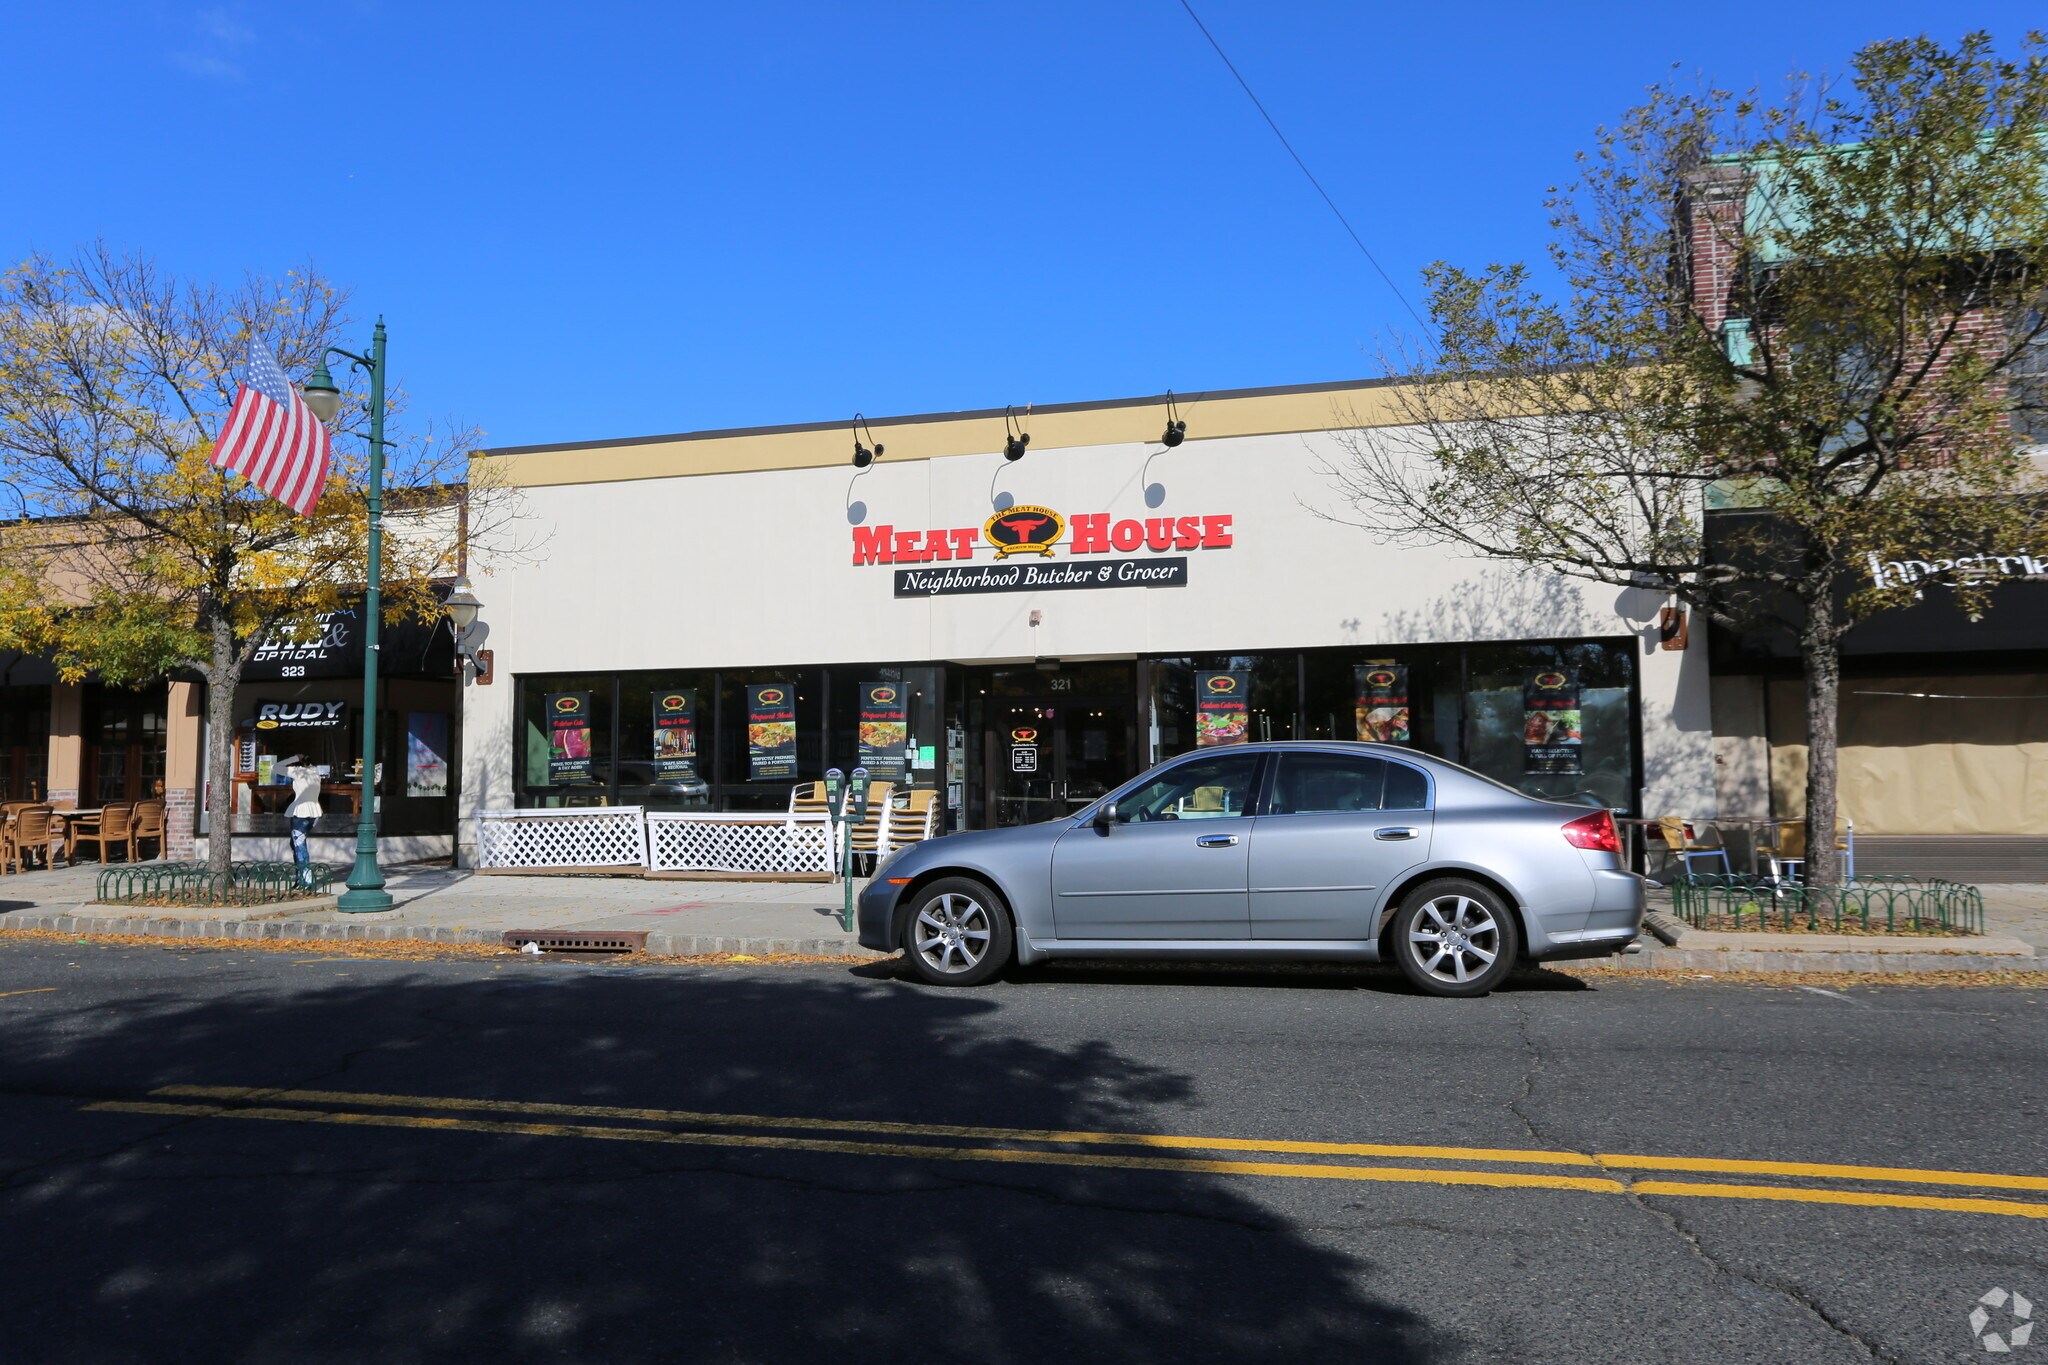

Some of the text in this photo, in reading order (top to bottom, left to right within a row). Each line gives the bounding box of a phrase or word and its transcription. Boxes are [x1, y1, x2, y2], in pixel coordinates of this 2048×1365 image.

[991, 506, 1058, 521] THE MEAT HOUSE
[902, 562, 1178, 594] Neighborhood Butcher & Grocer
[253, 649, 328, 661] OPTICAL
[281, 666, 305, 677] 323
[1051, 679, 1071, 690] 321
